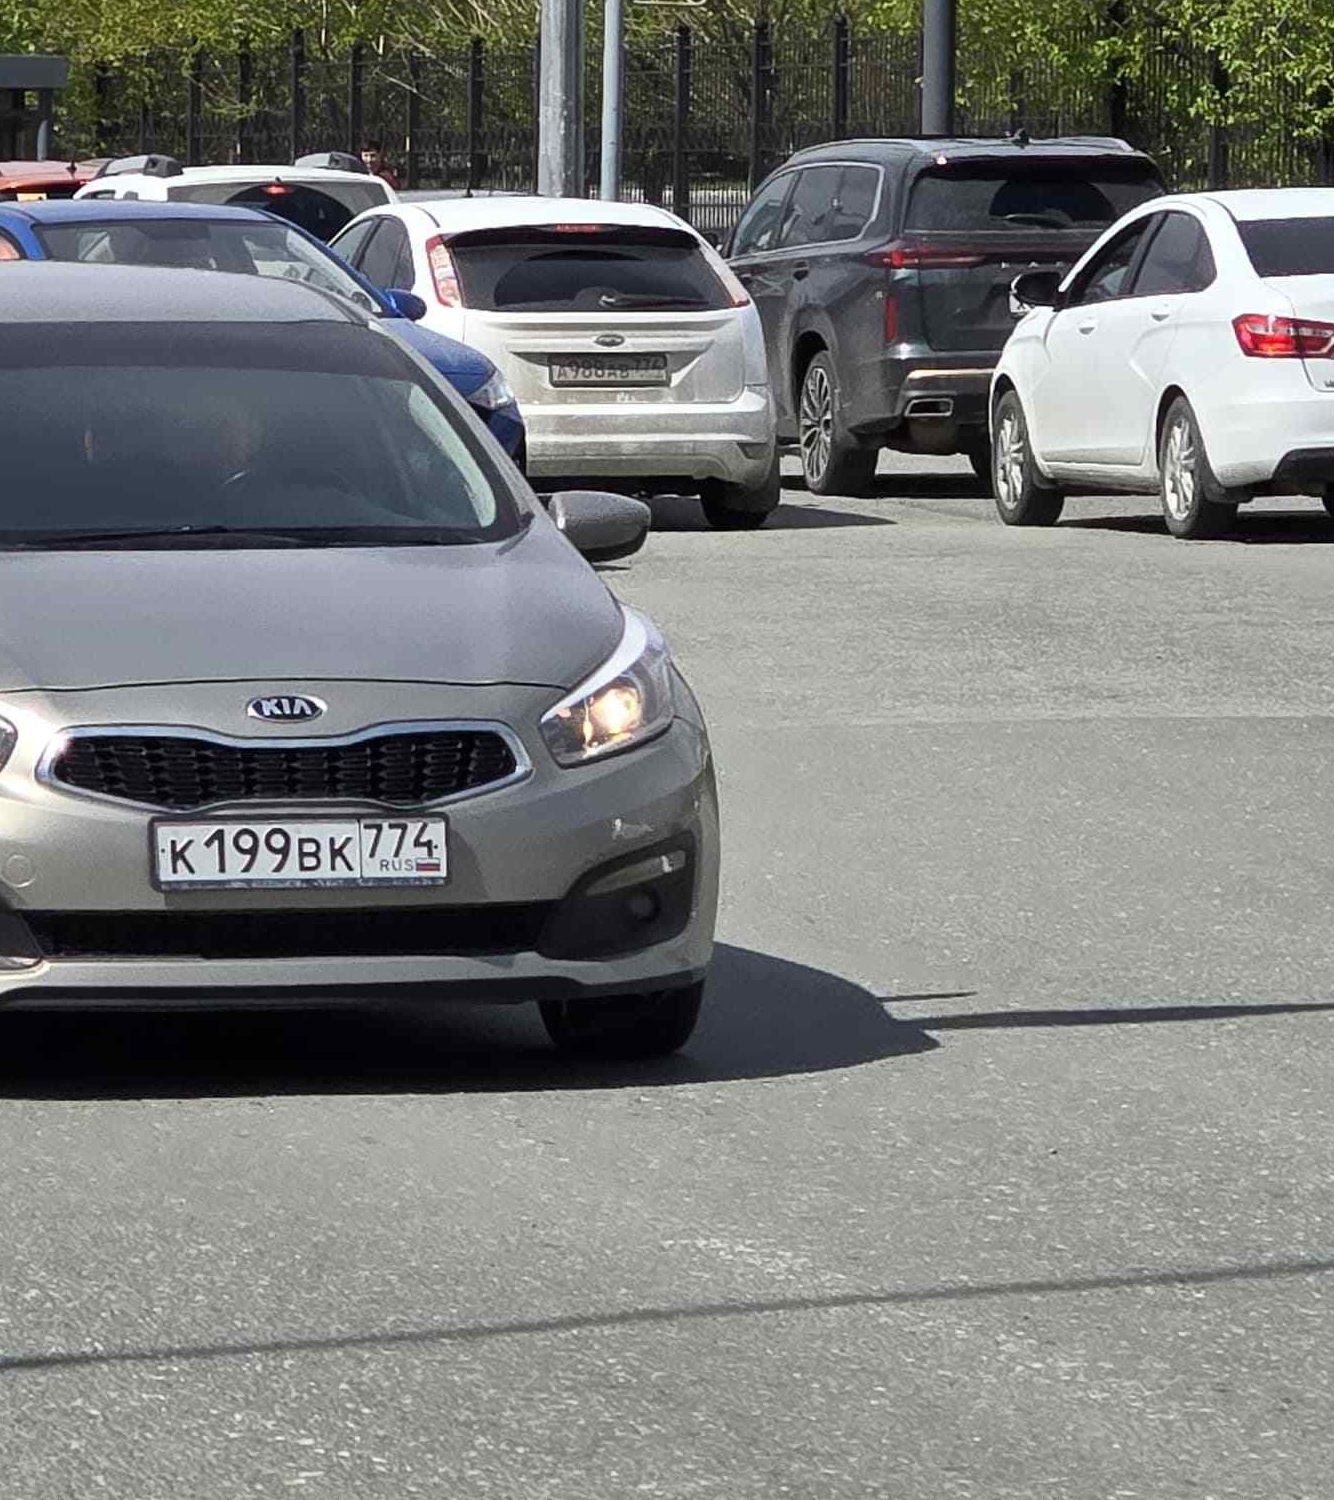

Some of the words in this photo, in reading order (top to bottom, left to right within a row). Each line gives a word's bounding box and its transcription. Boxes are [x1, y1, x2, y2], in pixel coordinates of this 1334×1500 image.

[261, 698, 312, 717] KIA
[170, 827, 356, 875] К199ВК
[363, 822, 433, 859] 774
[379, 858, 415, 873] RUS
